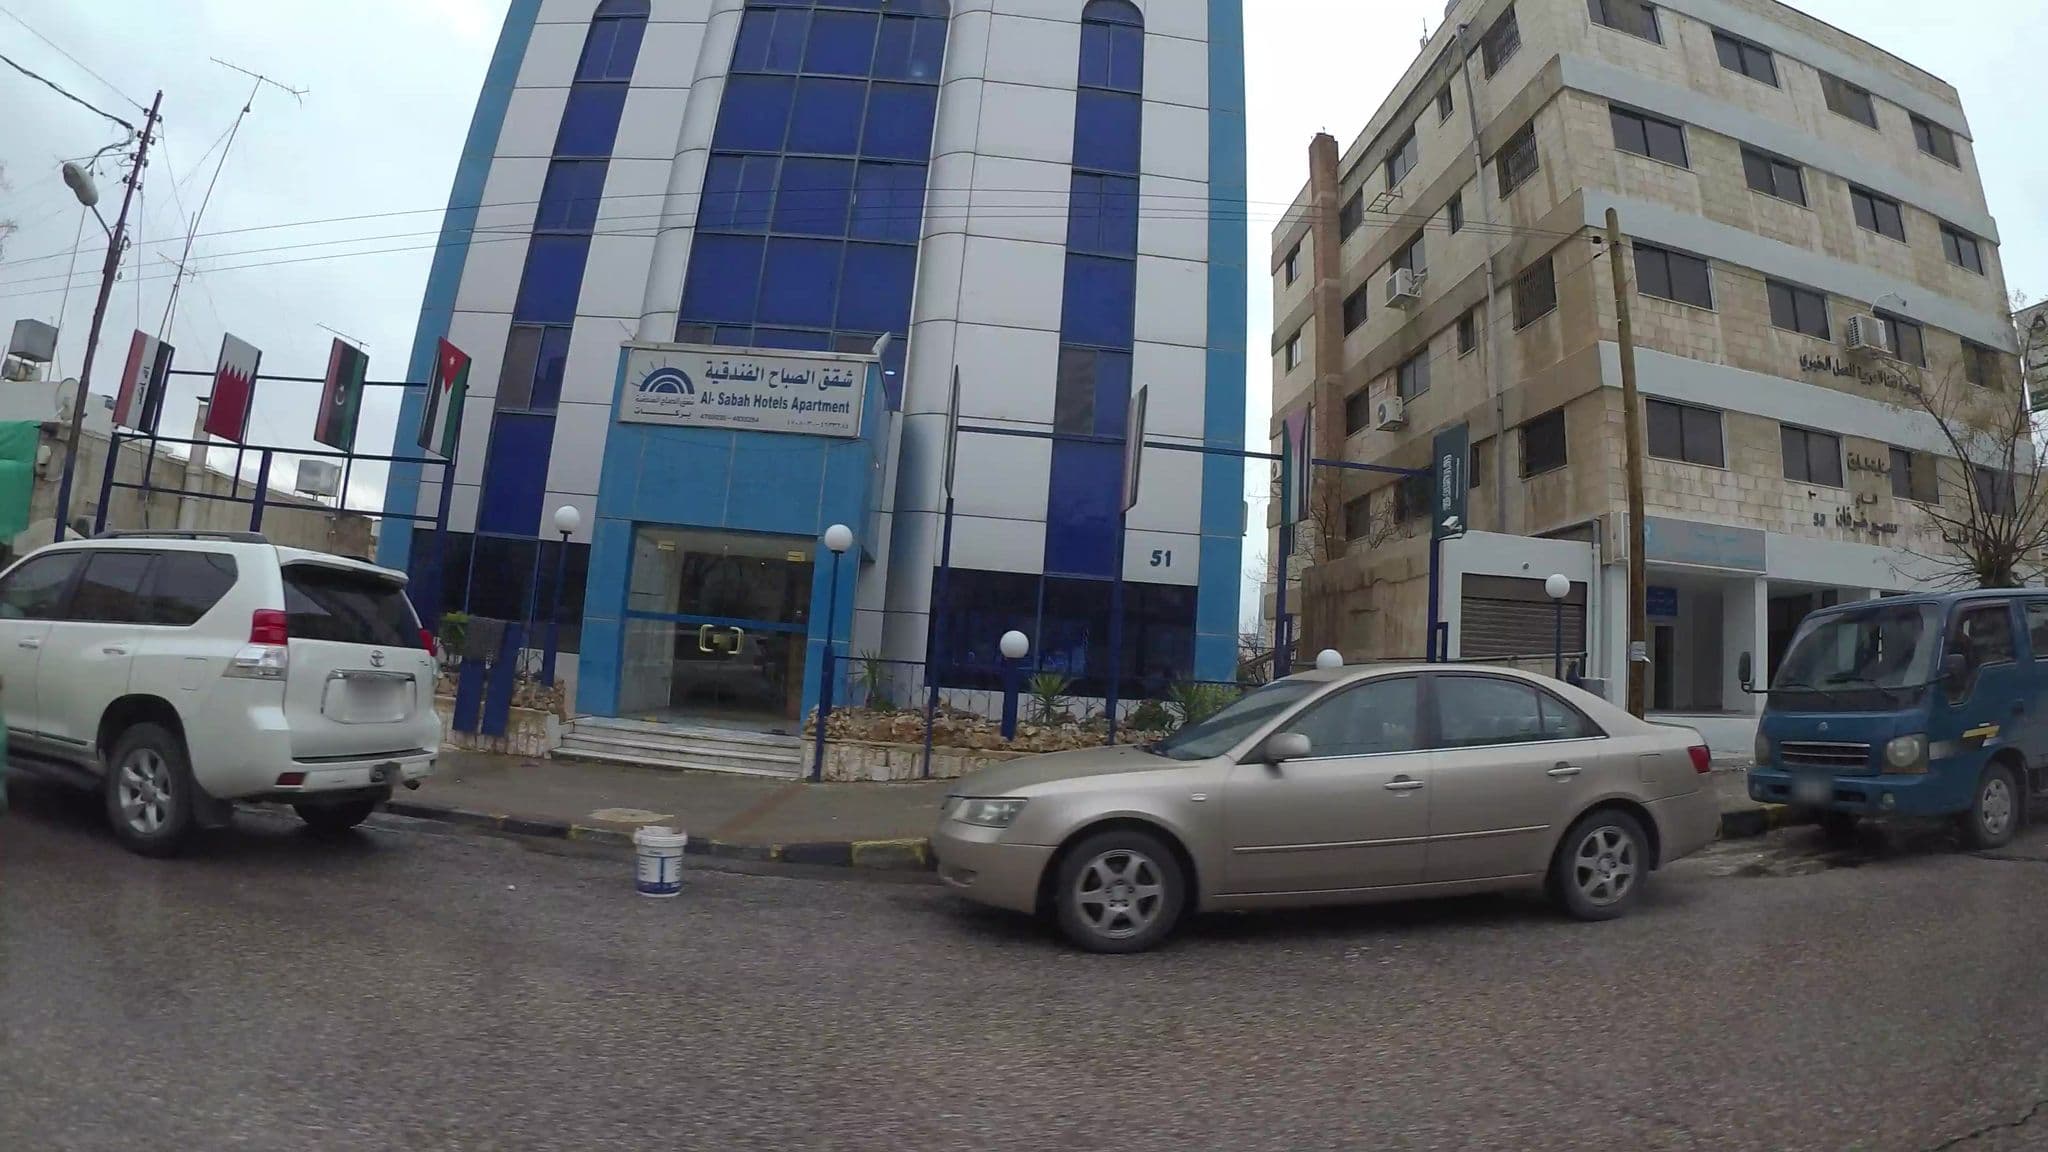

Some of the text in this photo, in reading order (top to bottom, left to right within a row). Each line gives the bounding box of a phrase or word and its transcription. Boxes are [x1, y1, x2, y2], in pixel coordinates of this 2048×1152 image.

[705, 360, 853, 391] شقق الصباح الفندقية
[718, 392, 751, 408] Sabah
[753, 394, 789, 410] Hotels
[791, 397, 850, 414] Apartment
[1150, 549, 1172, 568] 51
